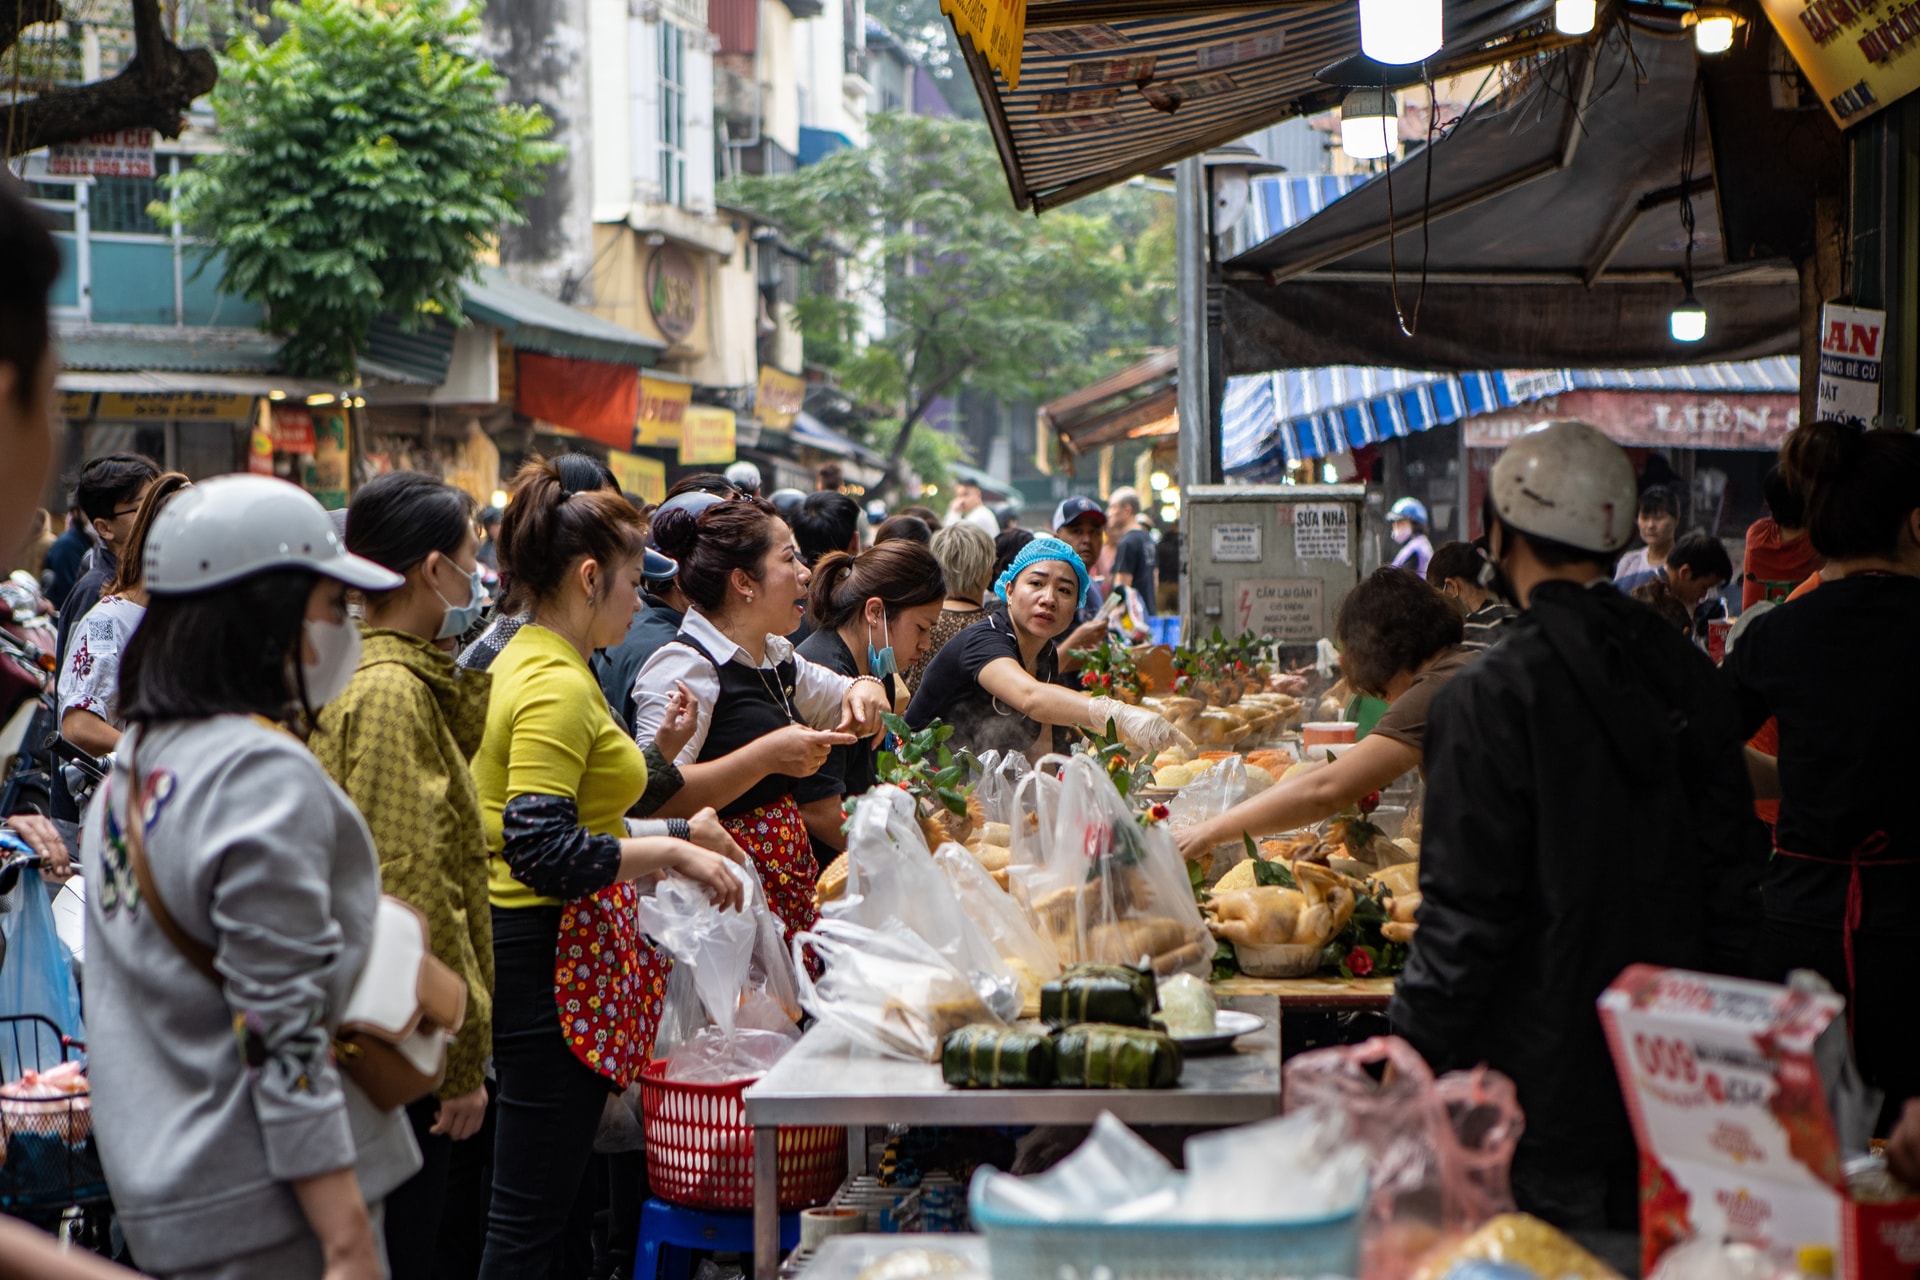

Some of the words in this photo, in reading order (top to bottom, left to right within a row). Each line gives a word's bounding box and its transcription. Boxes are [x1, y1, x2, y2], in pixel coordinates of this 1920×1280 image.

[1823, 321, 1880, 357] AN
[1655, 398, 1771, 433] LIÊN
[1297, 505, 1320, 528] SỬA
[1322, 506, 1347, 528] NHÀ
